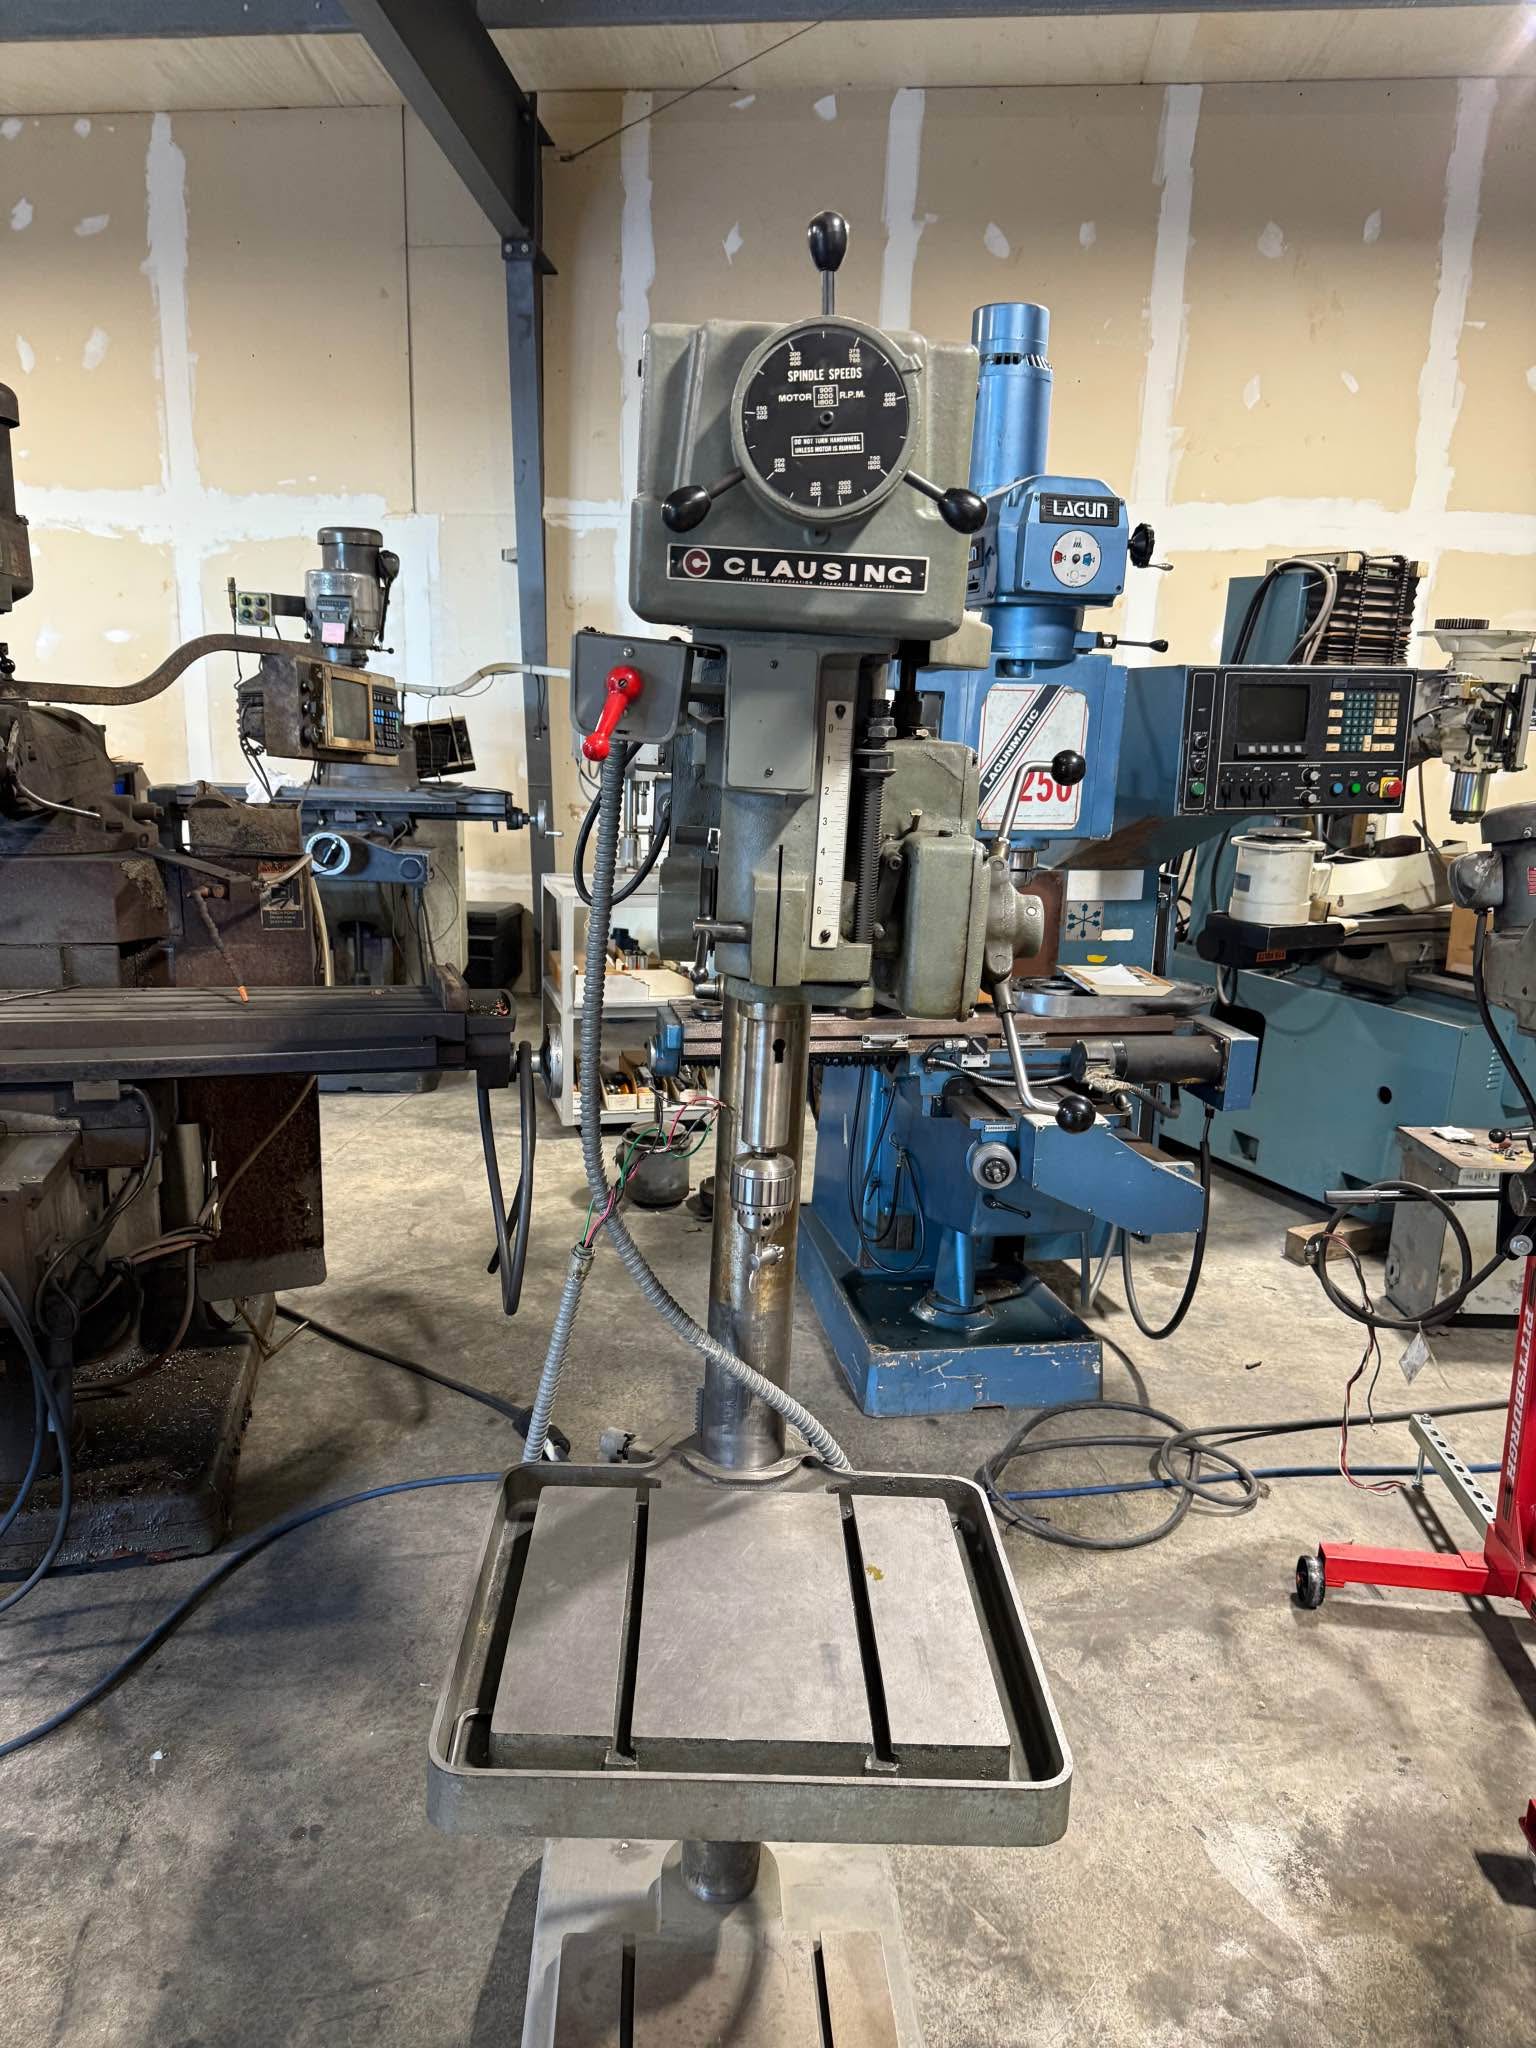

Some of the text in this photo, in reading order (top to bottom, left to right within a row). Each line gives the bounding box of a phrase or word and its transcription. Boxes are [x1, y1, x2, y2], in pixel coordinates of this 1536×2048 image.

[787, 367, 863, 383] SPINDLE SPEEDS
[778, 393, 812, 403] MOTOR
[839, 390, 866, 399] R.P.M.
[814, 445, 832, 453] MOTOR
[1053, 500, 1108, 519] LAGUN
[723, 557, 913, 584] CLAUSING
[983, 709, 1040, 789] LAGUNMATIC
[1507, 1304, 1534, 1486] PITTSBURGH
